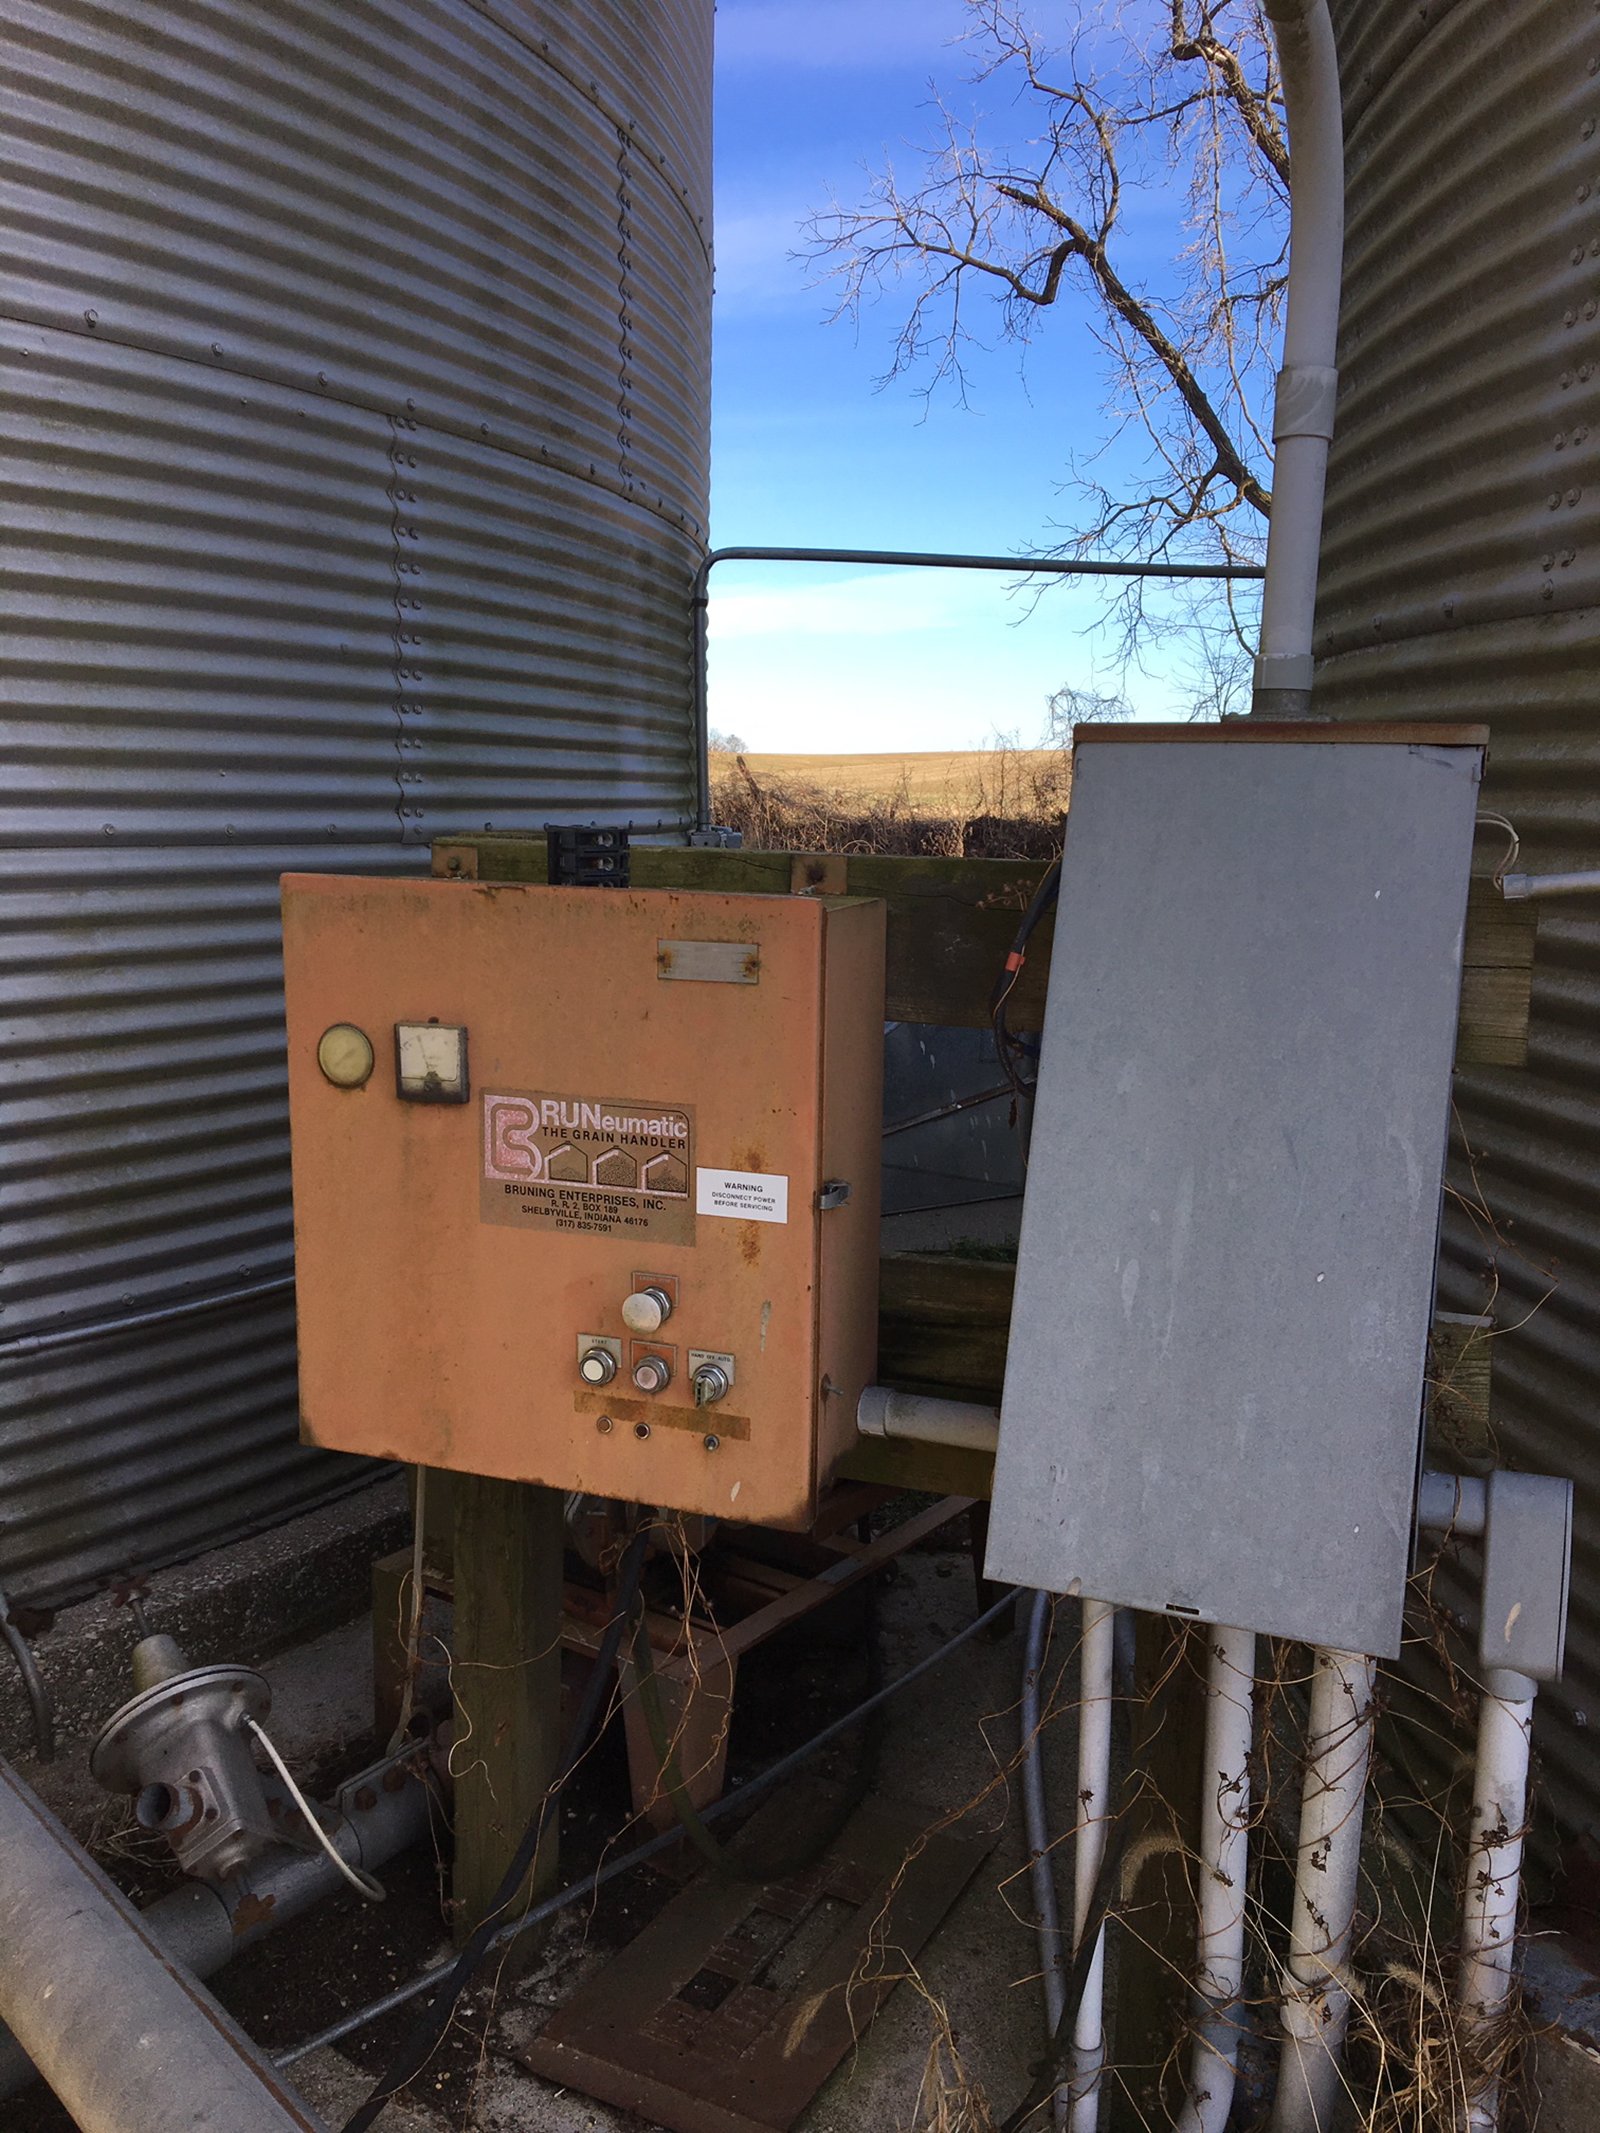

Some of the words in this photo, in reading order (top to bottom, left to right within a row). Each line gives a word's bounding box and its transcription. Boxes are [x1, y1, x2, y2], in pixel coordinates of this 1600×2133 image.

[542, 1127, 567, 1138] THE
[573, 1130, 614, 1143] GRAIN
[620, 1134, 686, 1149] HANDLER
[724, 1182, 763, 1192] WARNING
[504, 1184, 555, 1199] BRUNING
[559, 1190, 639, 1209] ENTERPRISES,
[643, 1199, 667, 1211] INC.
[711, 1192, 752, 1201] DISCONNECT
[583, 1203, 601, 1212] BOX
[604, 1205, 618, 1214] 189
[740, 1203, 773, 1211] SERVICING
[521, 1205, 582, 1220] SHELBYVILLE,
[584, 1212, 622, 1224] INDIANA
[624, 1217, 649, 1227] 46176
[555, 1219, 575, 1229] (317)
[577, 1221, 612, 1232] 835-7591
